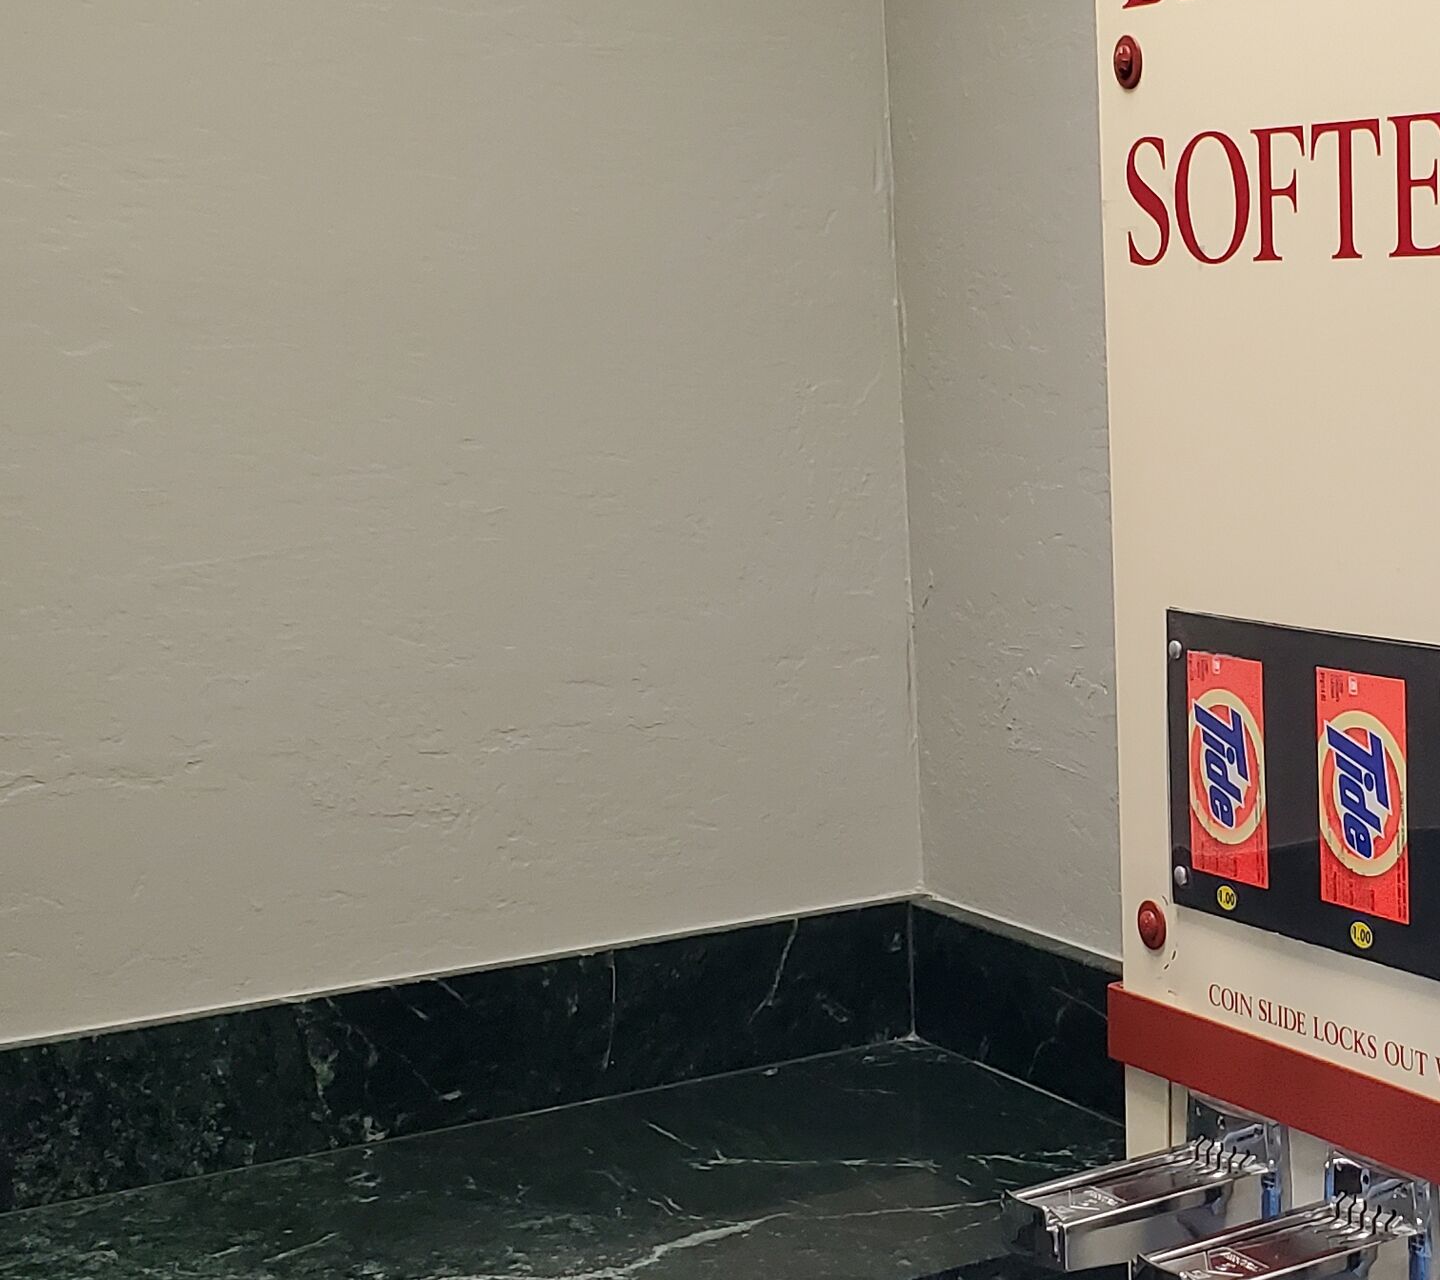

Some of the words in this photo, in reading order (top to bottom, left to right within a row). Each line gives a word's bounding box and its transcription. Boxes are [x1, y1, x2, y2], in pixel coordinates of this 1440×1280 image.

[1193, 700, 1250, 829] Tide
[1326, 723, 1391, 860] Tide
[1208, 983, 1254, 1018] COIN
[1258, 999, 1306, 1035] SLIDE
[1313, 1015, 1378, 1059] LOCKS
[1384, 1041, 1429, 1076] OUT
